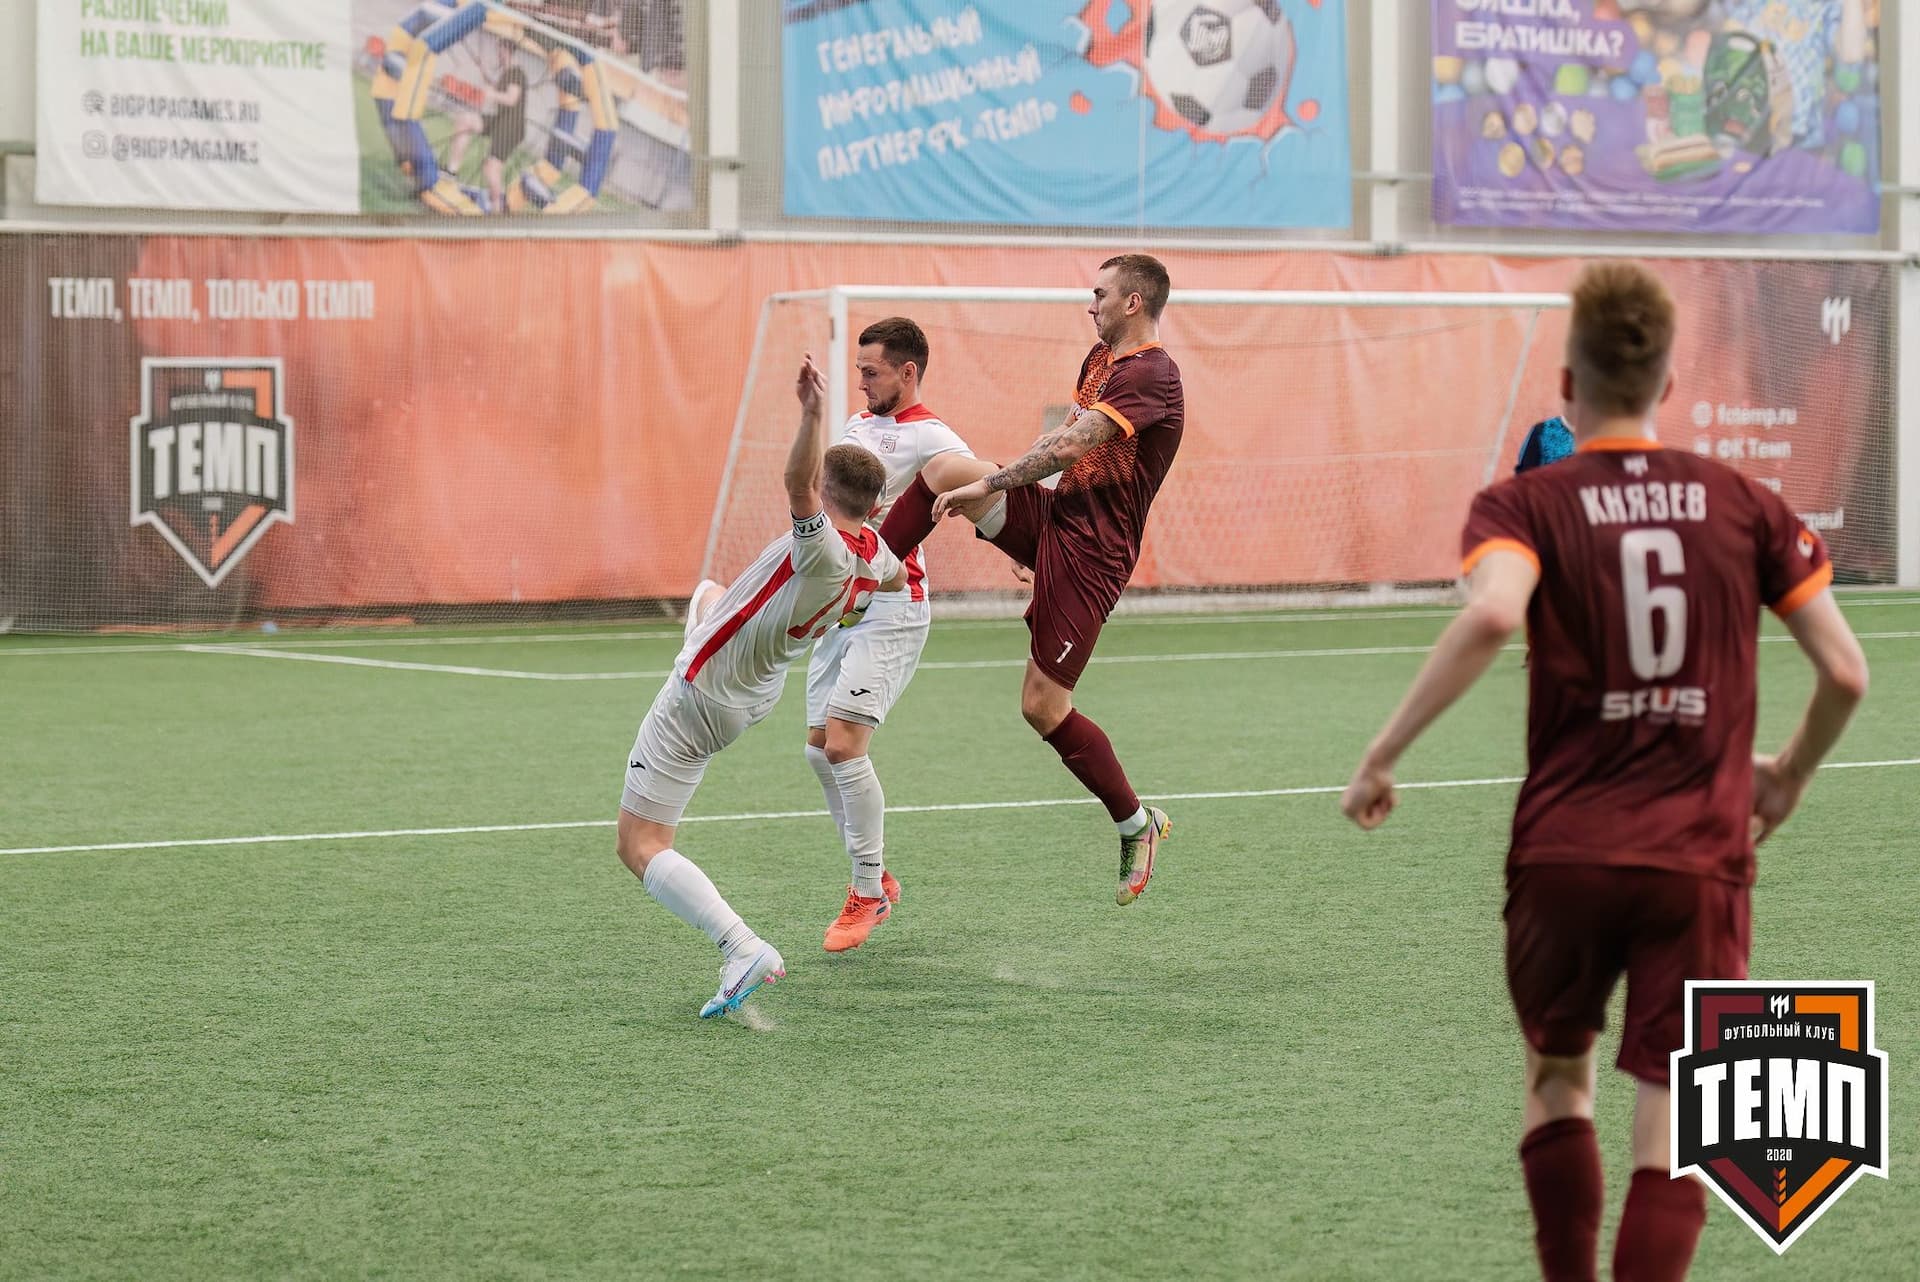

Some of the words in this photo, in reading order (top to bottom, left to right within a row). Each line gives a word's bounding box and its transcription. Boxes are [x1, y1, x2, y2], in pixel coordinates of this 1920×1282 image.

[80, 30, 109, 57] НА
[114, 32, 175, 62] ВАШЕ
[181, 36, 325, 70] МЕРОПРИЯТИЕ
[817, 5, 982, 74] ГЕНЕРАЛЬНЫЙ
[1455, 20, 1625, 57] БРАТИШКА?
[110, 93, 260, 123] BIGPAPAGAMES.RU
[818, 43, 1041, 129] ИНФОРМАЦИОННЫЙ
[111, 133, 258, 164] @BIGPAPAGAMES
[817, 127, 924, 181] ПАРТНЕР
[927, 118, 969, 154] ФК
[48, 277, 122, 322] ТЕМП,
[128, 278, 200, 323] ТЕМП,
[206, 278, 299, 320] ТОЛЬКО
[304, 280, 375, 320] ТЕМП!
[148, 421, 279, 499] ТЕМП
[1580, 481, 1707, 525] КНЯЗЕВ
[1619, 528, 1688, 682] 6
